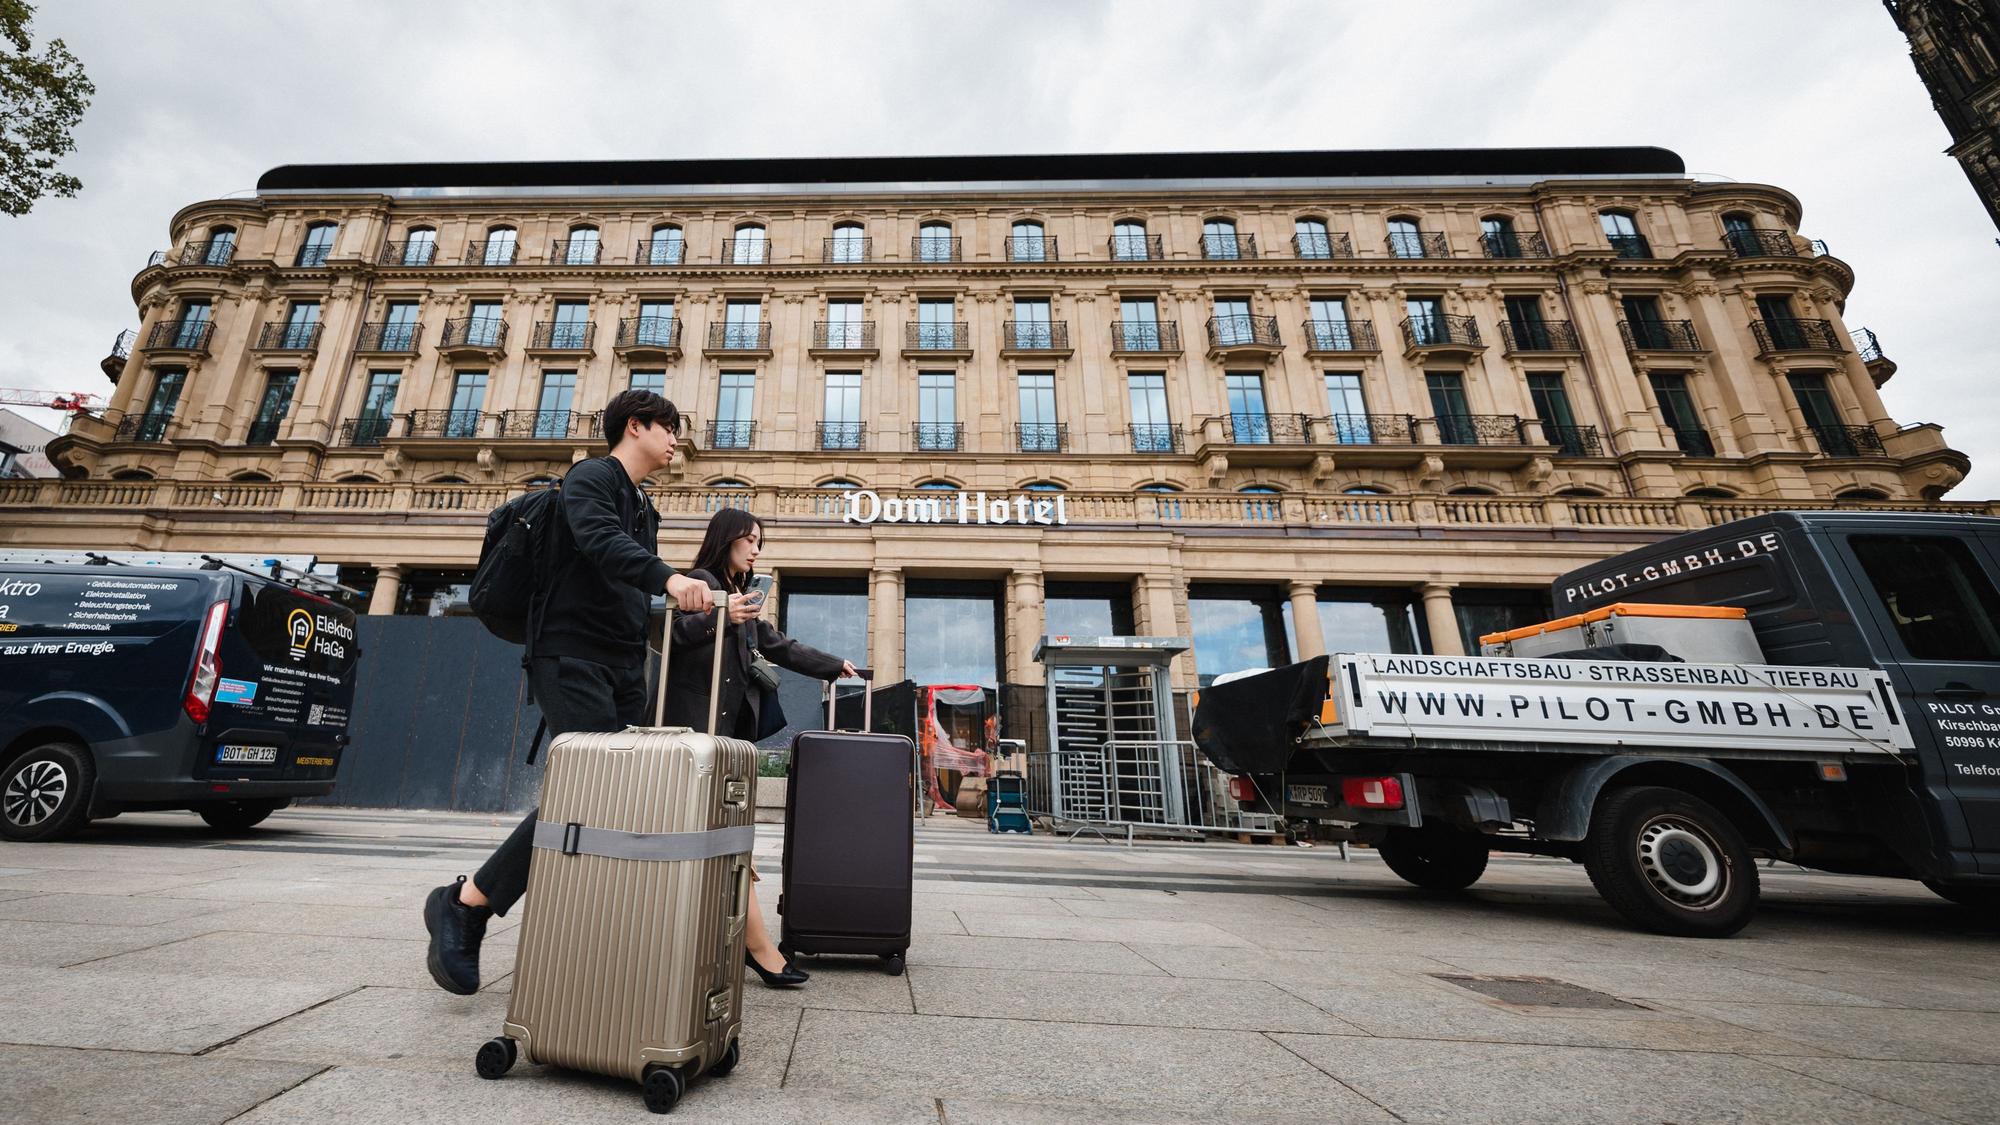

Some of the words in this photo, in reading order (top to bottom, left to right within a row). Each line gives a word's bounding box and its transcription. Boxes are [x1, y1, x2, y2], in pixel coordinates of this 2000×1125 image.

[843, 490, 942, 523] Dom
[958, 491, 1068, 525] Hotel
[1565, 533, 1779, 602] PILOT-GMBH.DE
[0, 578, 41, 596] ktro
[161, 583, 178, 591] MSR
[85, 591, 146, 600] Elektroinstallation
[79, 601, 151, 611] Beleuchtungstechnik
[73, 611, 138, 621] Sicherheitstechnik
[67, 622, 111, 631] Photovoltaik
[316, 615, 353, 640] Elektro
[4, 645, 28, 655] aus
[31, 643, 63, 654] Ihrer
[65, 641, 116, 656] Energie.
[314, 636, 345, 659] HaGa
[1374, 658, 1572, 681] LANDSCHAFTSBAU
[1589, 664, 1749, 685] STRASSENBAU
[1764, 670, 1859, 688] TIEFBAU
[1377, 690, 1874, 730] WWW.PILOT-GMBH.DE
[1927, 702, 1976, 714] PILOT
[1945, 736, 1985, 748] 50996
[224, 747, 242, 759] BOT
[247, 748, 259, 760] GH
[259, 748, 276, 760] 123
